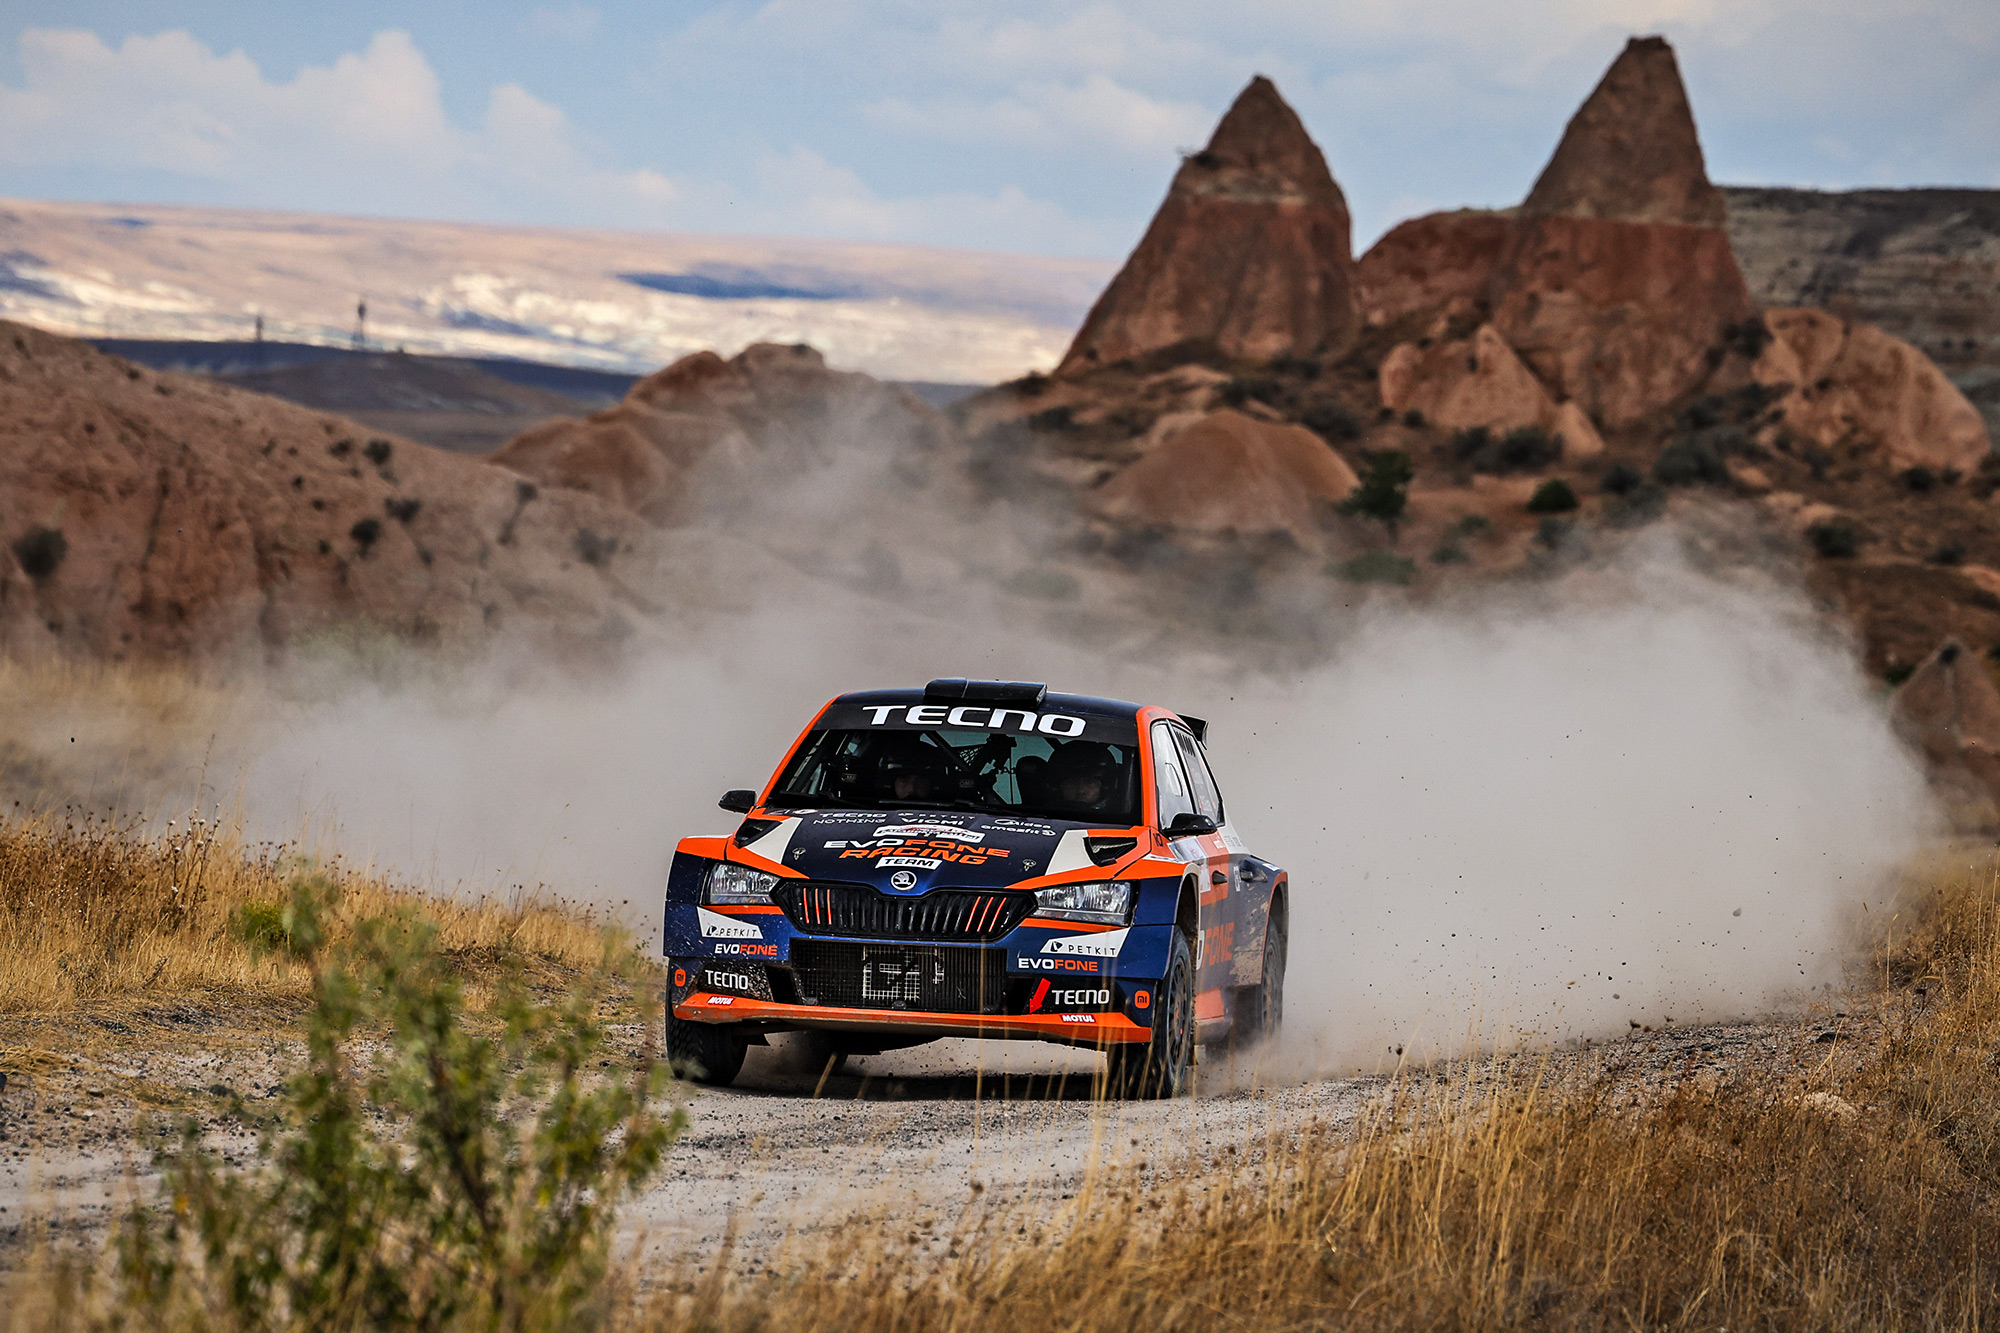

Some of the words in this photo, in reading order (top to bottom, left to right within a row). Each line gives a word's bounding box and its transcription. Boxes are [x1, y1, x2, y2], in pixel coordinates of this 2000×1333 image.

[862, 705, 1087, 737] TECNO
[901, 817, 964, 826] VIOMI
[823, 838, 1011, 858] EVOFONE
[839, 847, 989, 865] RACING
[884, 858, 936, 868] TEAM
[719, 927, 758, 937] PETKIT
[714, 943, 779, 956] EVOFONE
[1068, 944, 1117, 955] PETKIT
[1018, 957, 1099, 972] EVOFONE
[704, 969, 749, 990] TECNO
[707, 996, 734, 1005] MOTUL
[1051, 989, 1110, 1005] TECNO
[1061, 1014, 1096, 1023] MOTUL
